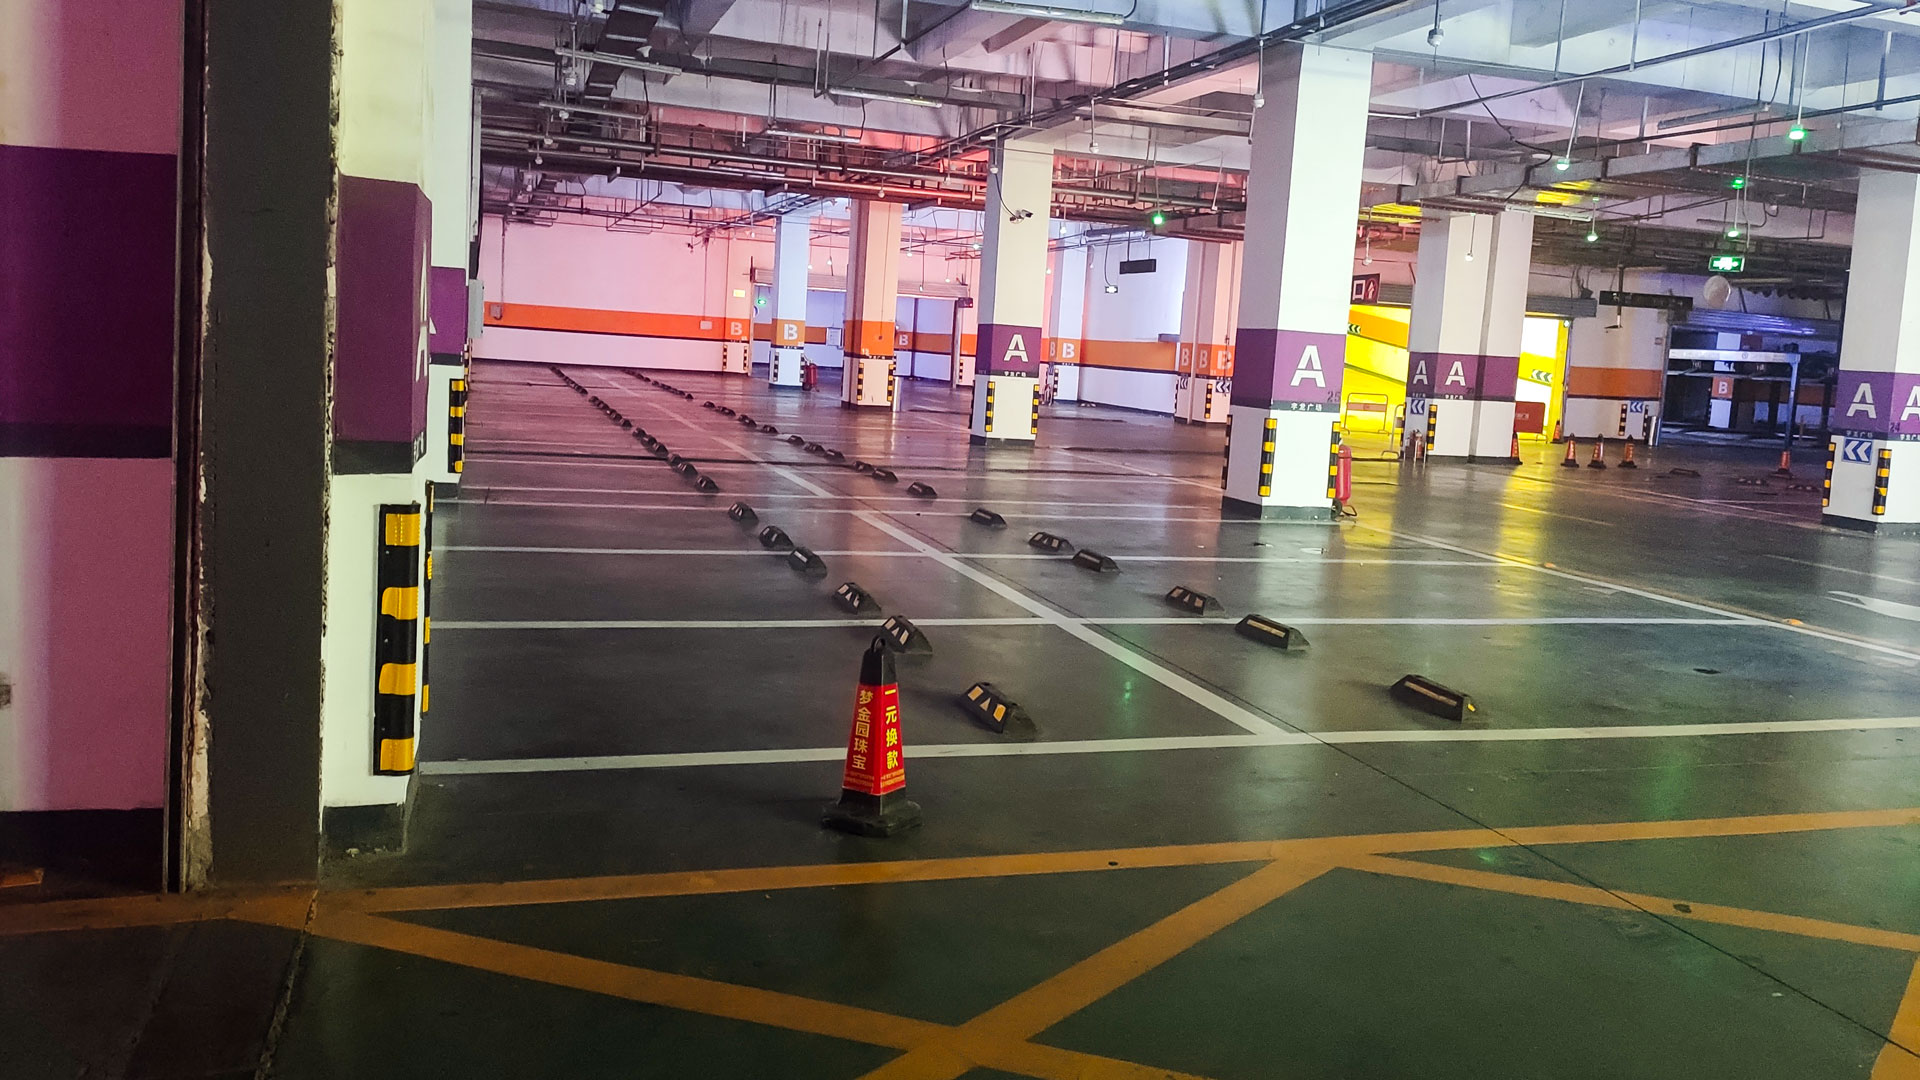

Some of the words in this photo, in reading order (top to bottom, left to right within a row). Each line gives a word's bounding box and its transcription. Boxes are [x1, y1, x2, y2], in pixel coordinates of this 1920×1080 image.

[730, 321, 743, 336] B
[783, 323, 798, 340] B
[899, 334, 909, 346] B
[1003, 334, 1029, 363] A
[1062, 342, 1075, 359] B
[1181, 348, 1190, 367] B
[1200, 350, 1208, 369] B
[1217, 350, 1232, 370] B
[1290, 344, 1326, 388] A
[1412, 360, 1429, 385] A
[1444, 361, 1466, 386] A
[1718, 382, 1728, 395] B
[1846, 382, 1877, 419] A
[1900, 385, 1920, 421] A
[852, 690, 873, 770] 梦金园珠宝
